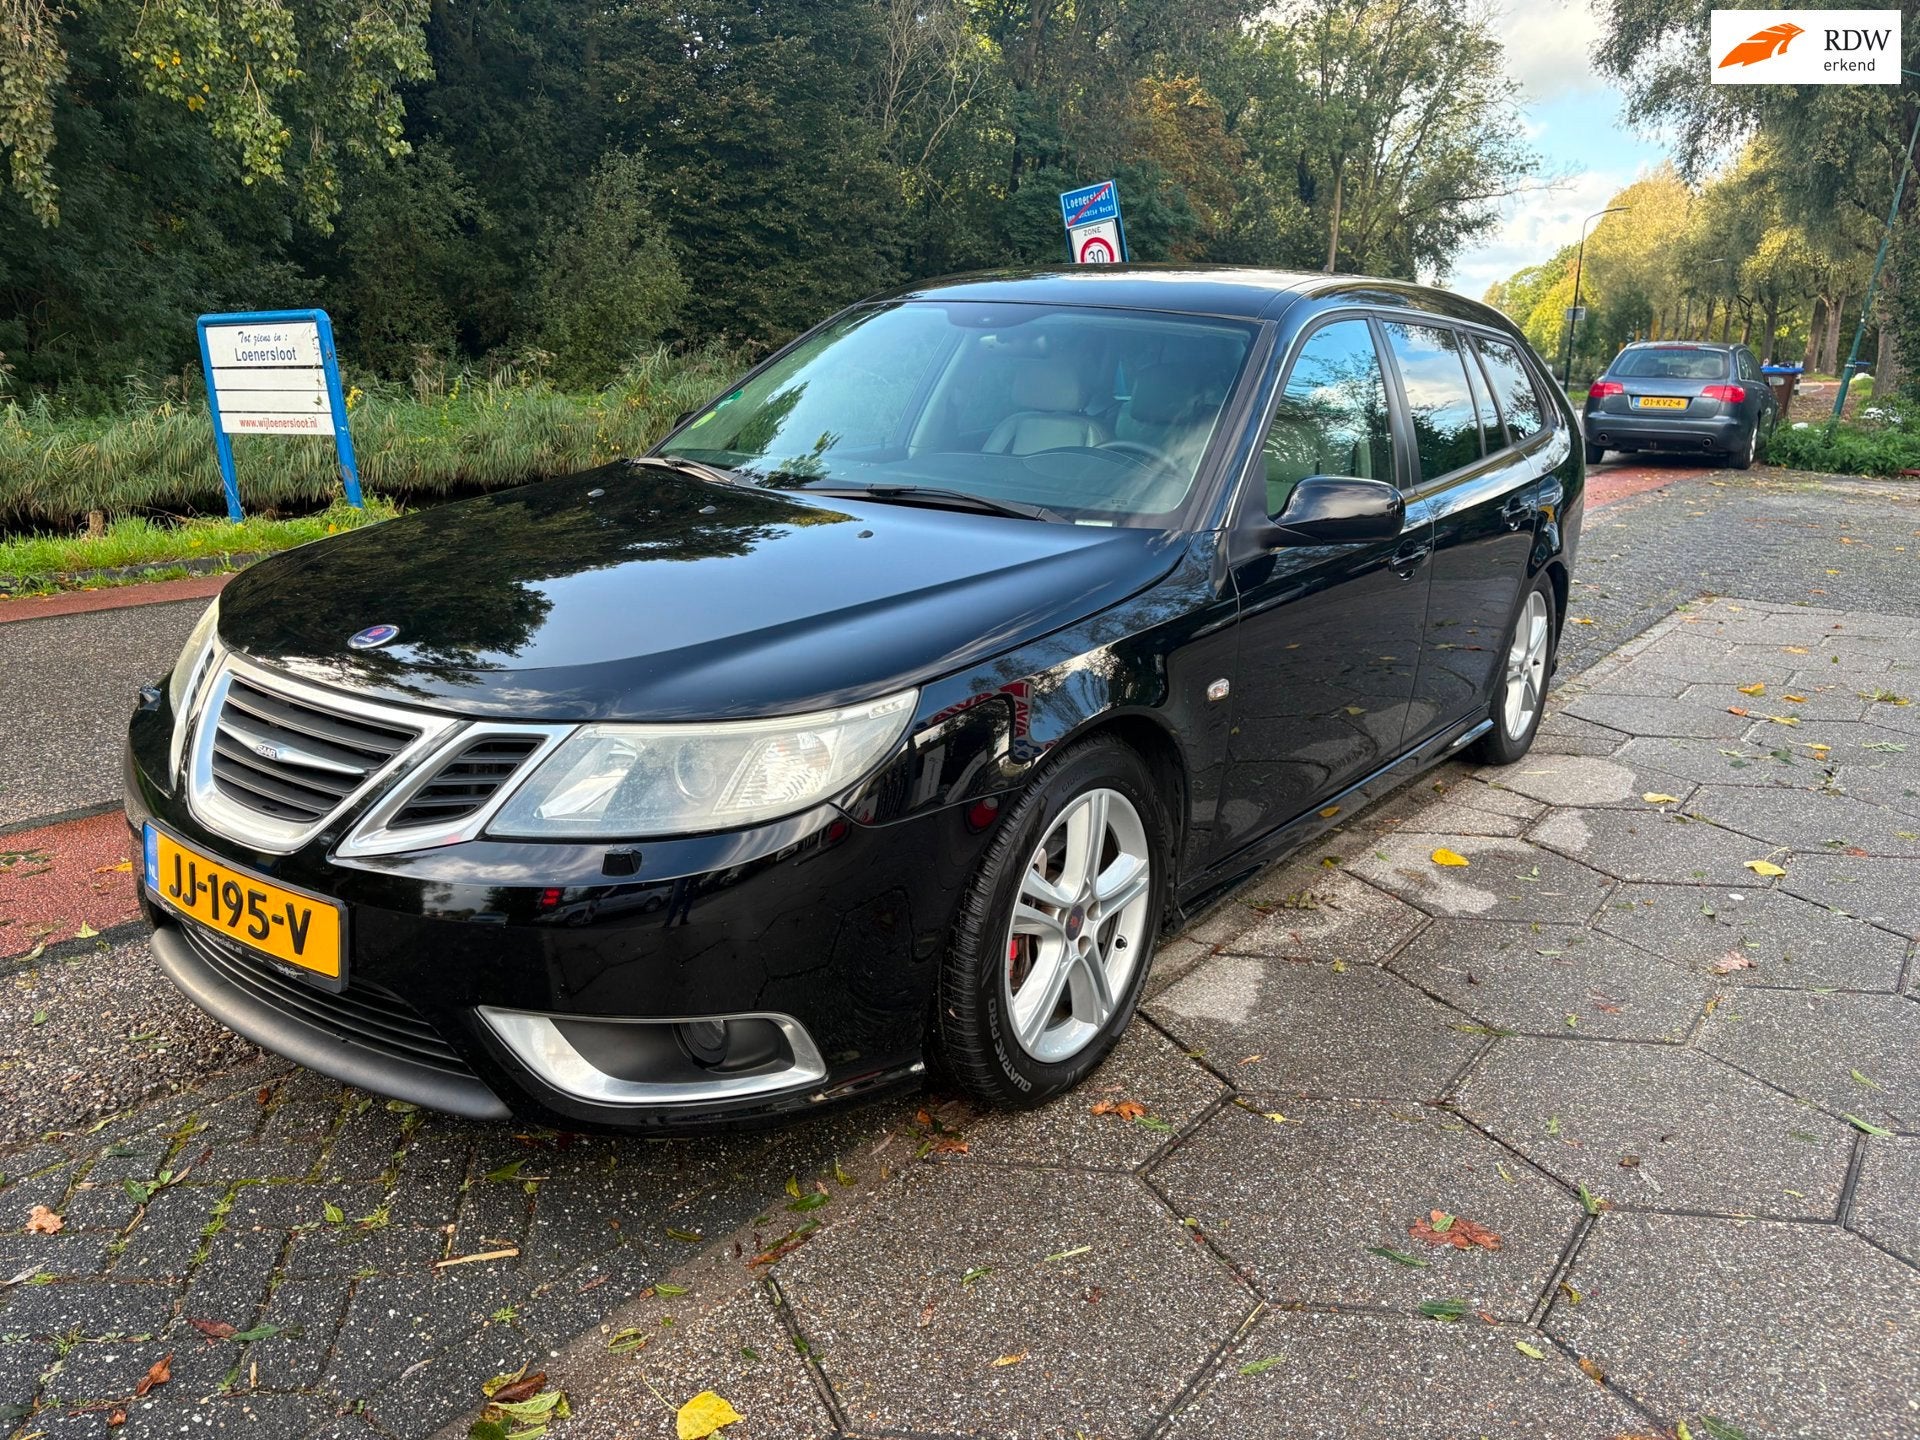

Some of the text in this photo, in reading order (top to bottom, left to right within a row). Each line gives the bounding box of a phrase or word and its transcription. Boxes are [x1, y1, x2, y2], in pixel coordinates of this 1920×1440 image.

[1083, 226, 1102, 237] ZONE
[1088, 249, 1105, 263] 30
[238, 331, 251, 343] Tot
[253, 333, 271, 346] ziens
[234, 346, 297, 361] Loenersloot
[239, 417, 318, 430] www.wijloenersloot.nl
[257, 744, 276, 759] SAAB
[169, 853, 312, 956] JJ-195-V
[988, 998, 1032, 1093] QUATRAC PRO
